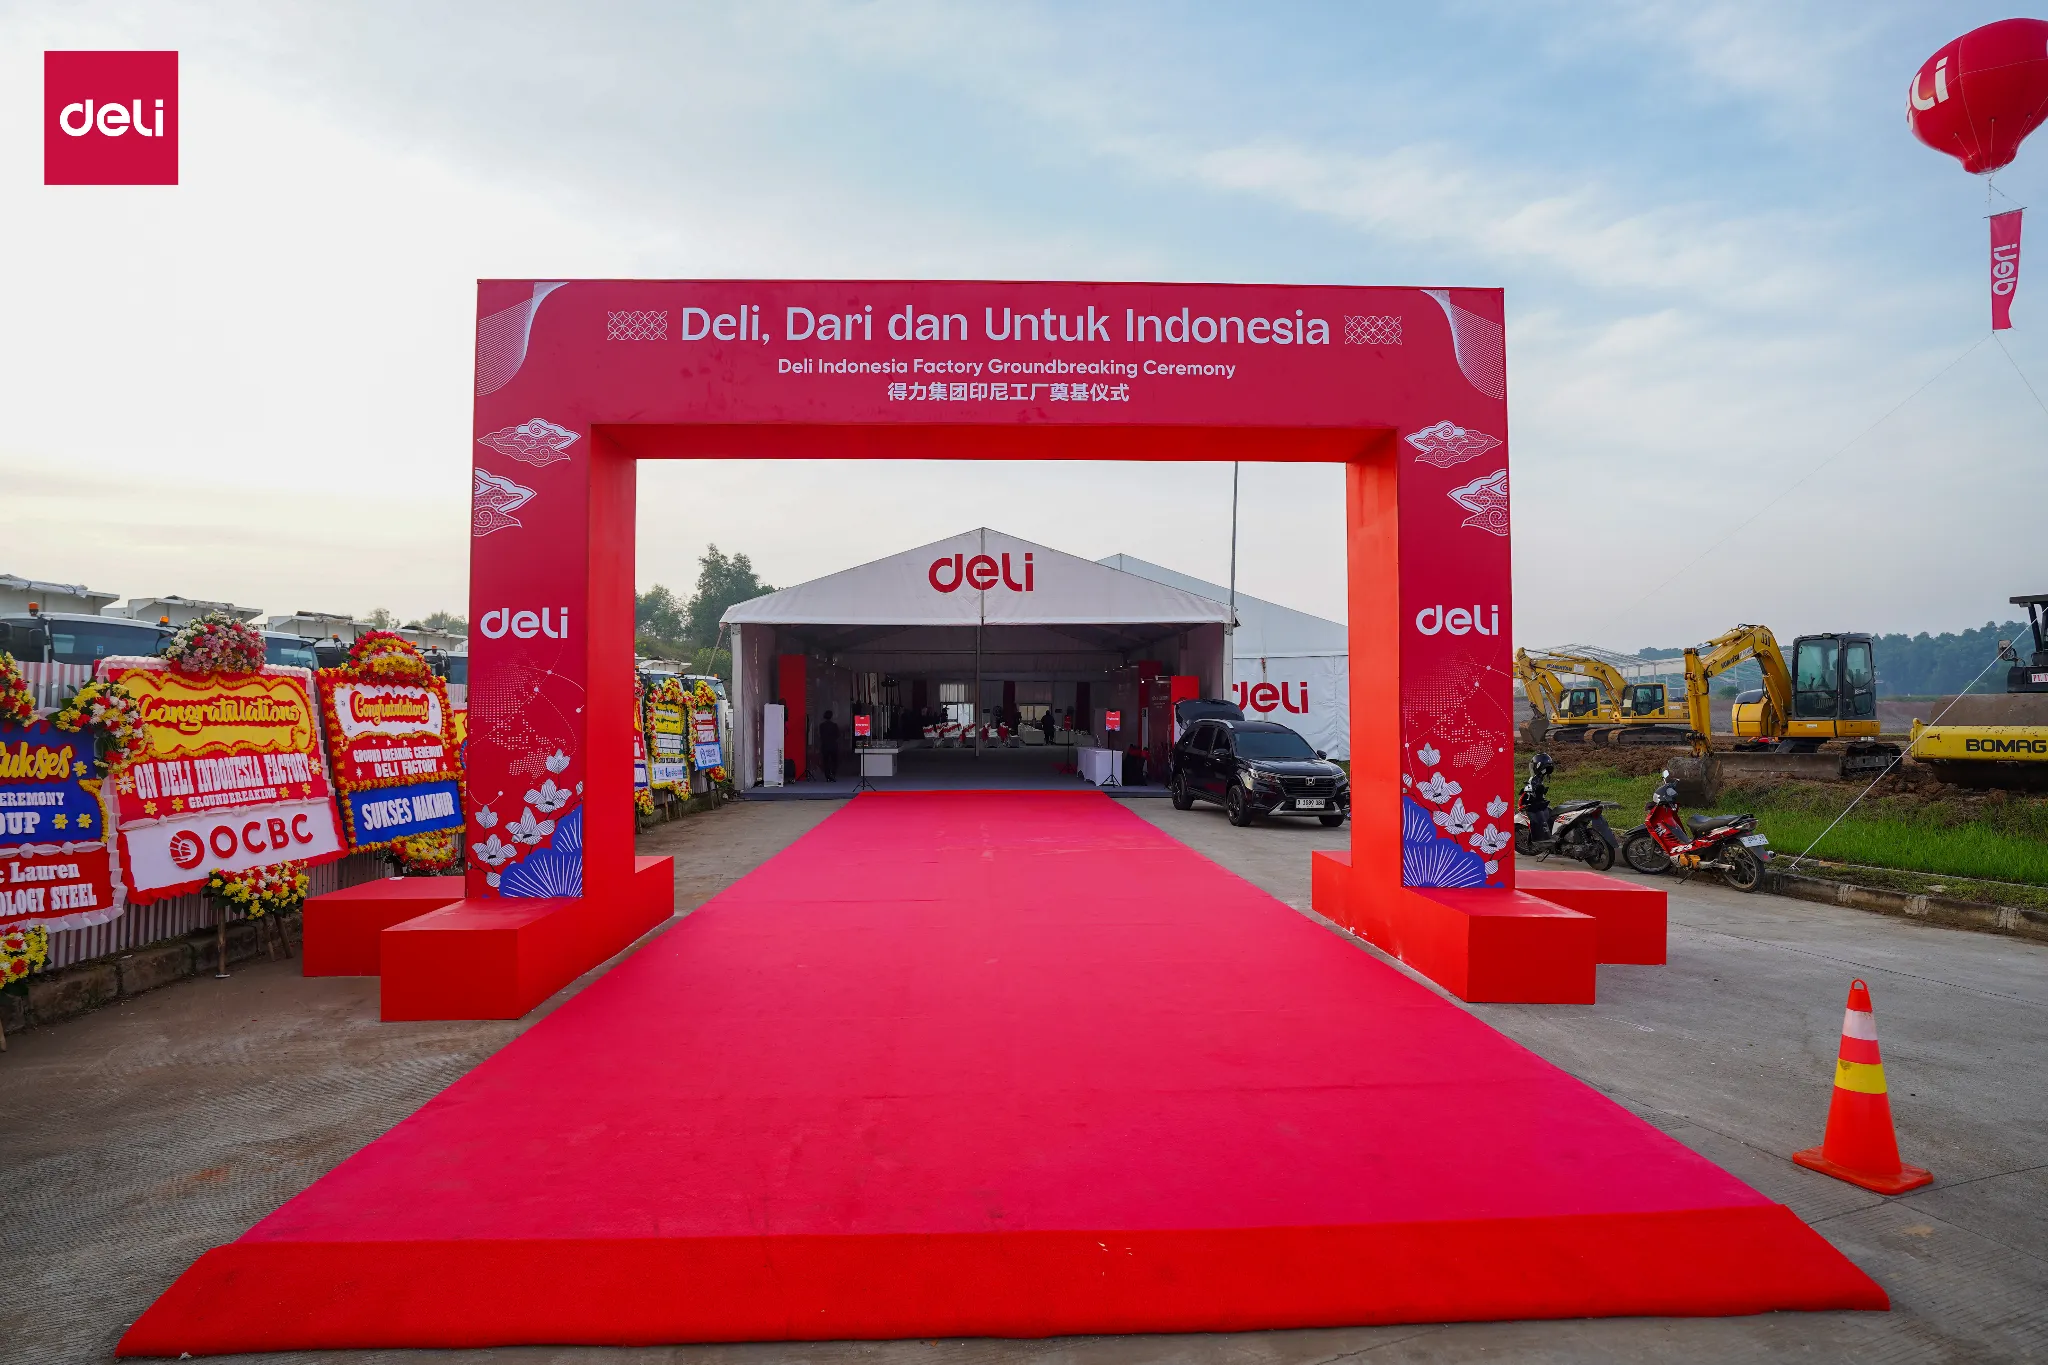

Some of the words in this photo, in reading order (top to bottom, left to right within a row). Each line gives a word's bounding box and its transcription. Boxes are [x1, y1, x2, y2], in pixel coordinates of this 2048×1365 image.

[682, 304, 770, 346] Deli,
[787, 304, 873, 341] Dari
[888, 304, 968, 341] dan
[986, 306, 1110, 342] Untuk
[1127, 308, 1330, 345] Indonesia
[778, 358, 813, 374] Deli
[818, 358, 908, 375] Indonesia
[914, 359, 983, 377] Factory
[988, 358, 1138, 379] Groundbreaking
[1143, 360, 1236, 380] Ceremony
[887, 382, 1130, 402] 得力集团印尼工厂奠基仪式
[928, 553, 1034, 593] deli
[481, 607, 569, 639] deli
[1416, 604, 1499, 636] deli
[353, 749, 381, 763] GROUND
[381, 747, 413, 760] BREAKING
[413, 745, 444, 759] CEREMONY
[1965, 738, 2047, 754] BOMAG
[134, 763, 158, 800] ON
[158, 760, 194, 798] DELI
[194, 755, 265, 794] INDONESIA
[263, 753, 313, 785] FACTORY
[374, 761, 399, 778] DELI
[402, 759, 437, 775] FACTORY
[361, 797, 413, 831] SUKSES
[412, 792, 455, 822] MAKMUR
[209, 813, 314, 859] OCBC
[9, 861, 81, 884] Lauren
[50, 882, 98, 911] STEEL
